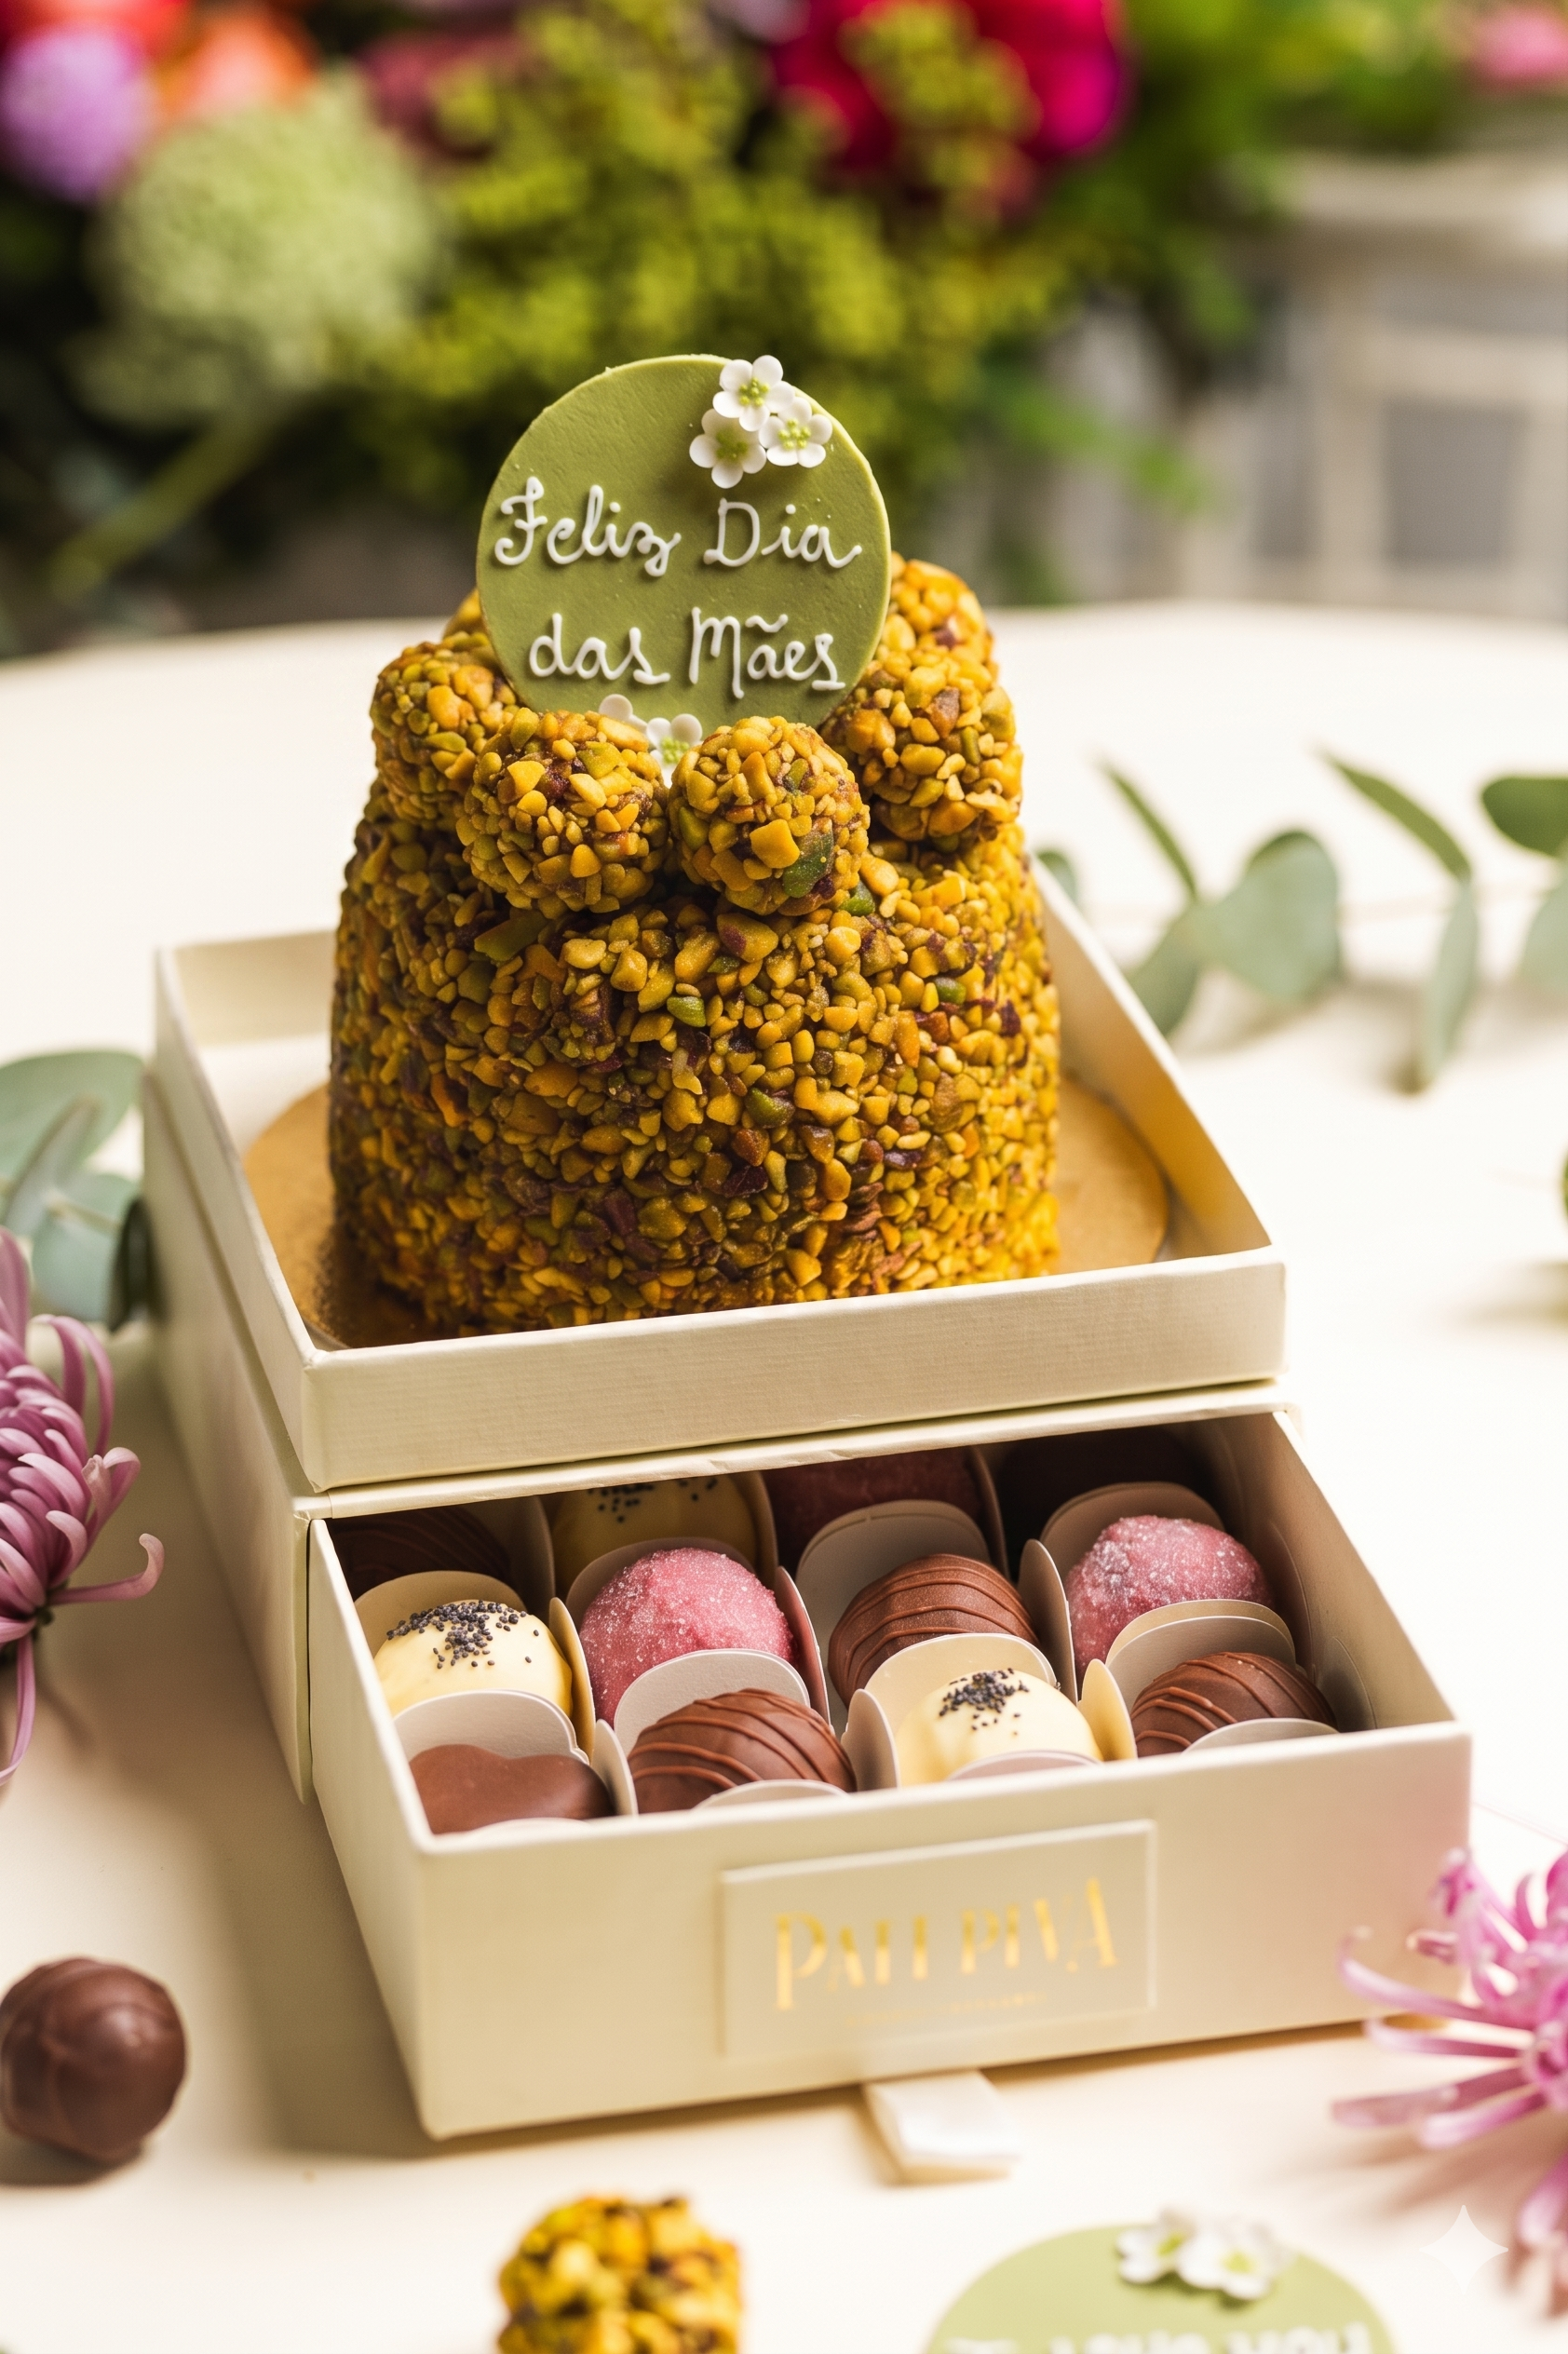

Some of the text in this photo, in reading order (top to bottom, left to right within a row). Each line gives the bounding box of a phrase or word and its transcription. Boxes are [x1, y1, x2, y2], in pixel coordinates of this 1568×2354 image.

[494, 476, 862, 576] Feliz Dia
[529, 606, 845, 698] das Mães
[960, 1876, 1118, 1976] PIVA
